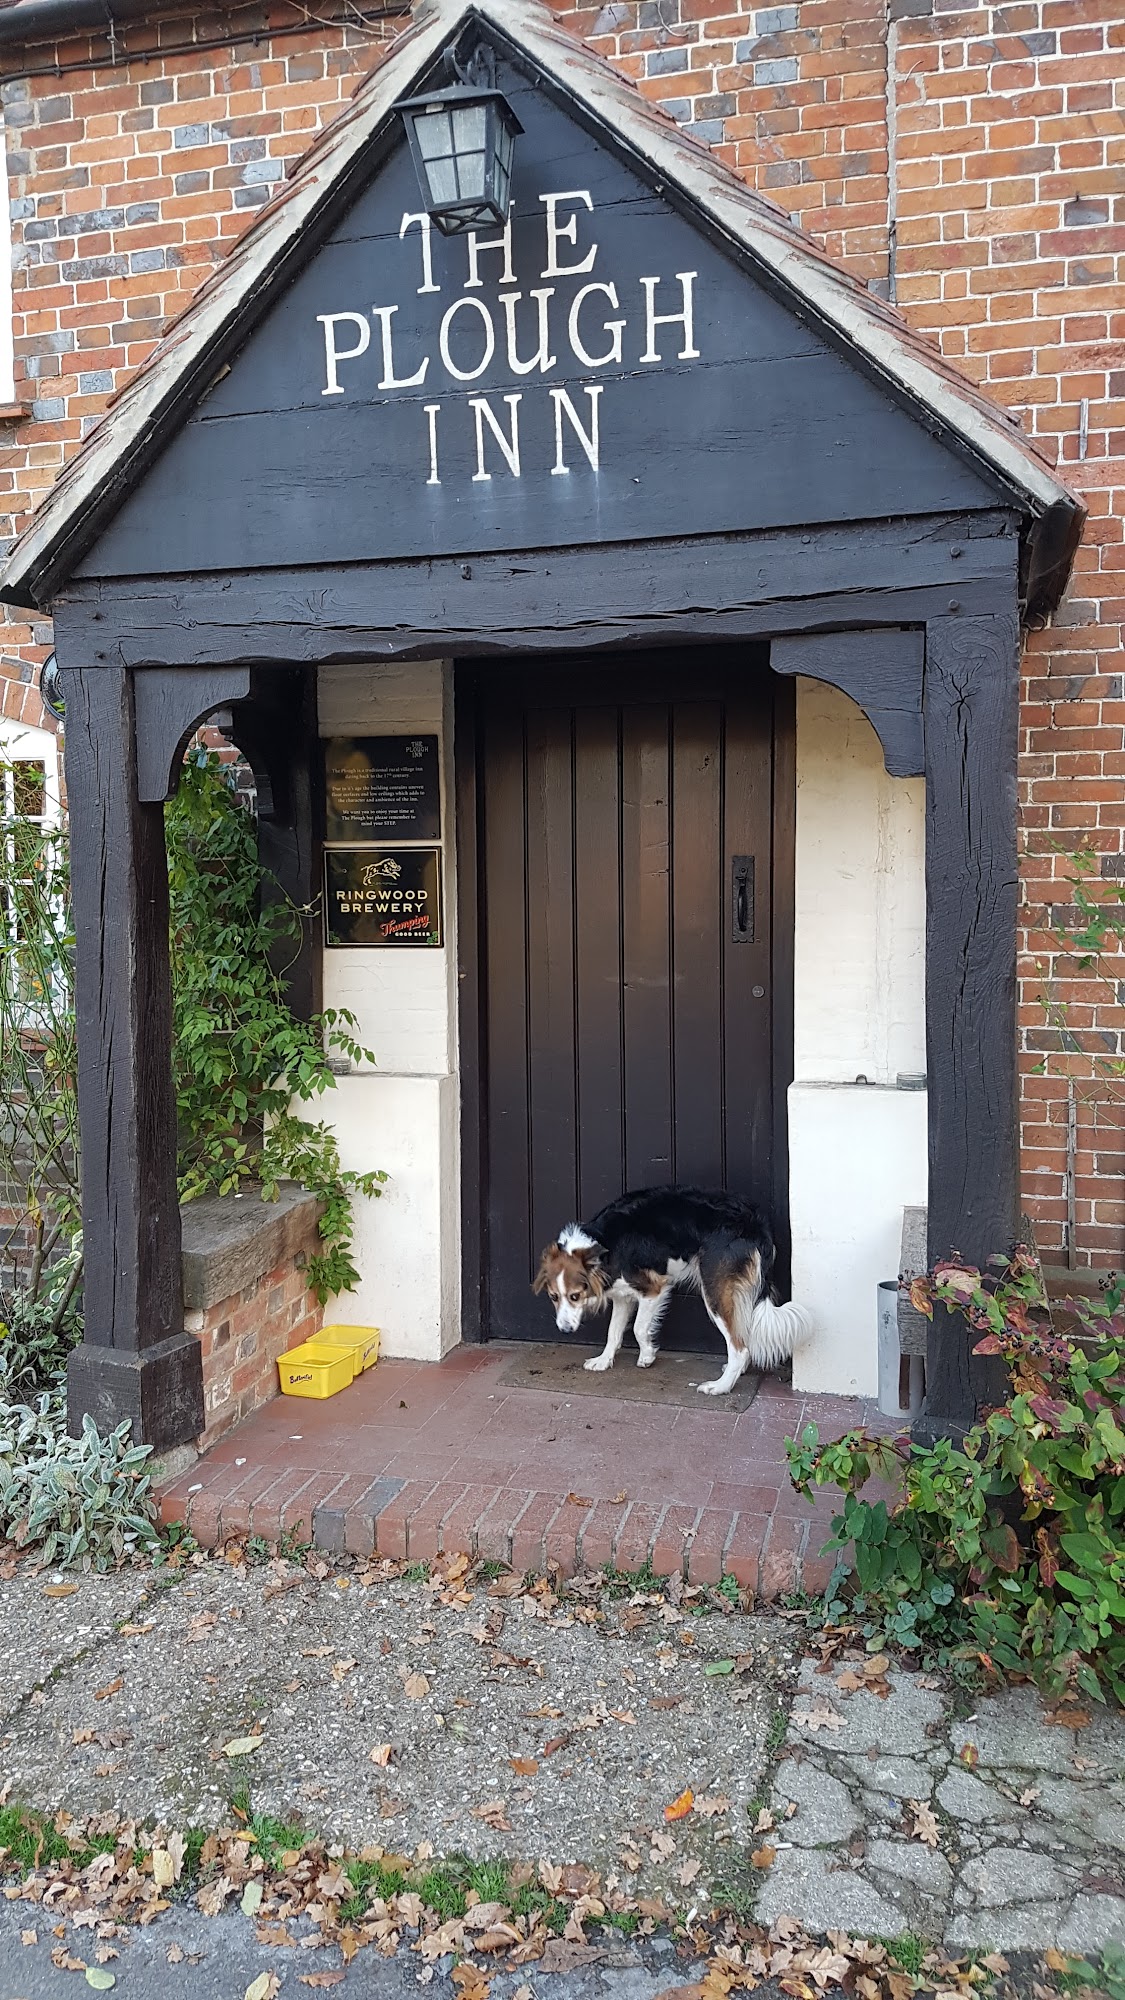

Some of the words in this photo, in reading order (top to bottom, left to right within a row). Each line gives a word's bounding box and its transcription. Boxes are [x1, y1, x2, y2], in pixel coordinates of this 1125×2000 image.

[399, 190, 598, 294] THE
[316, 271, 701, 396] PLOUGH
[424, 385, 604, 485] INN
[336, 890, 428, 900] RINGWOOD
[340, 902, 424, 913] BREWERY
[380, 915, 431, 936] Thumping
